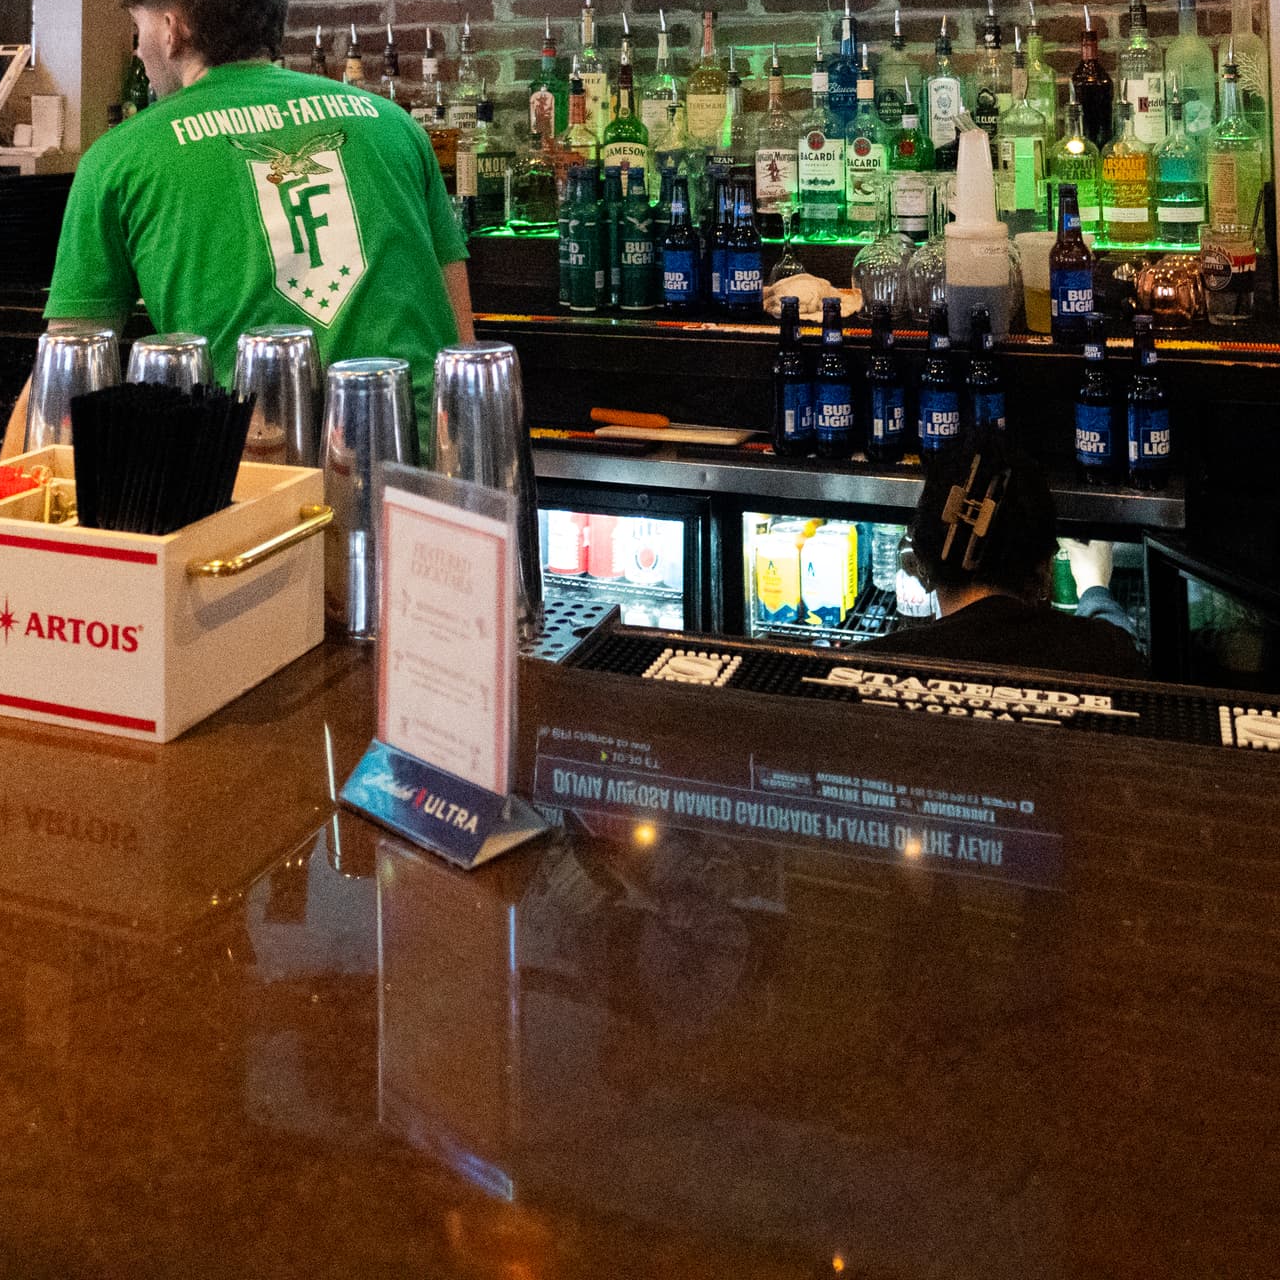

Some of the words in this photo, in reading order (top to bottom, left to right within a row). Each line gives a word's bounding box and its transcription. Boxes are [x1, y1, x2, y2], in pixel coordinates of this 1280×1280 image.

[170, 104, 285, 145] FOUNDING
[286, 95, 380, 126] FATHERS
[606, 147, 646, 157] JAMESON
[800, 150, 836, 161] BACARDÍ
[477, 157, 506, 173] KNOB
[847, 157, 881, 168] BACARDÍ
[625, 241, 653, 253] BUD
[734, 270, 760, 281] BUD
[730, 280, 762, 291] LIGHT
[1068, 289, 1093, 301] BUD
[823, 404, 851, 416] BUD
[932, 412, 959, 423] BUD
[24, 612, 139, 653] ARTOIS
[827, 666, 1114, 711] STATESIDE
[857, 688, 1078, 718] URBANCRAFT
[906, 701, 1016, 723] VODKA
[423, 794, 479, 834] ULTRA
